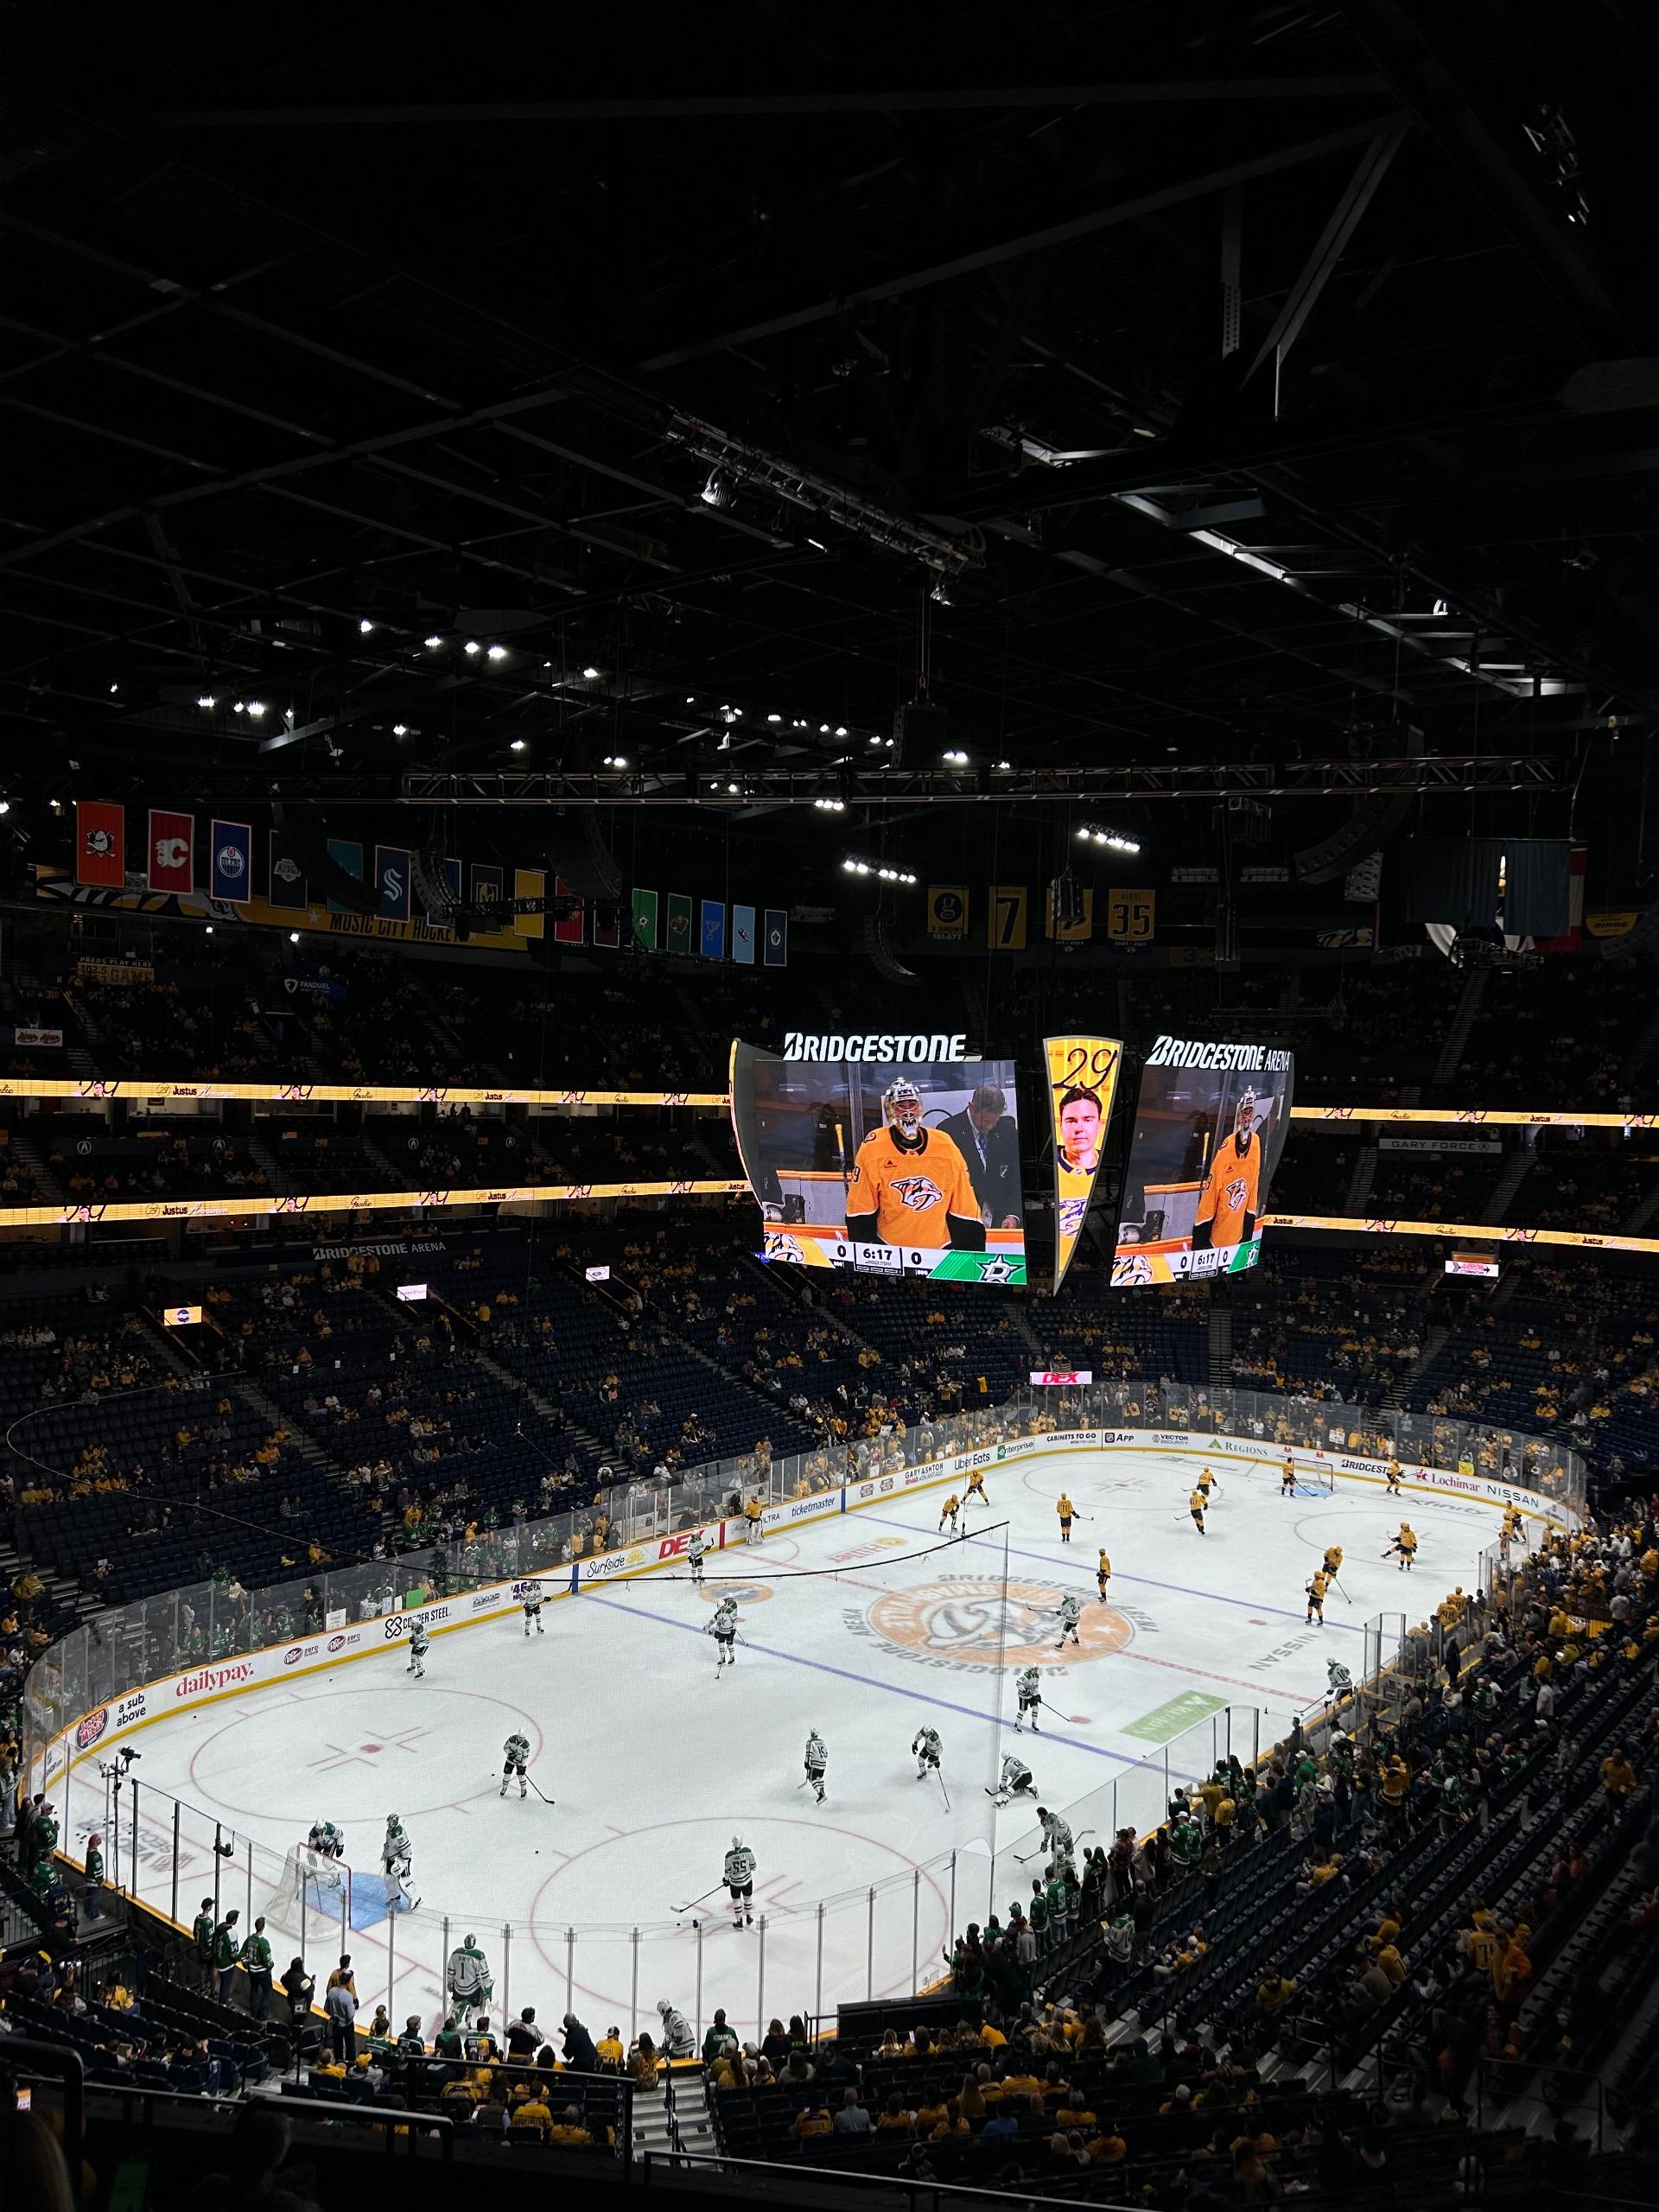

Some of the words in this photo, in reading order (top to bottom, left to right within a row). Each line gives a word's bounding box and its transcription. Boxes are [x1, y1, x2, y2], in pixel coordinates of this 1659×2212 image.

[330, 912, 373, 934] MUSIC
[378, 918, 408, 938] CITY
[995, 897, 1020, 944] 7
[1112, 903, 1152, 935] 35
[79, 957, 106, 965] PREDS
[300, 981, 330, 990] FANDUEL
[783, 1032, 966, 1062] BRIDGESTONE
[1145, 1035, 1265, 1071] BRIDGESTONE
[1264, 1050, 1290, 1071] ARENA
[1052, 1047, 1117, 1090] 29
[173, 1085, 197, 1096] Justus
[485, 1092, 503, 1101] Justus
[1391, 1141, 1426, 1149] GARY
[1432, 1141, 1475, 1151] FORCE
[488, 1192, 506, 1200] Justus
[162, 1205, 188, 1216] Justus
[312, 1243, 408, 1262] BRIDGESTONE
[411, 1241, 447, 1254] ARENA
[836, 1244, 847, 1258] 0
[862, 1249, 893, 1261] 6:17
[911, 1252, 922, 1265] 0
[1223, 1250, 1229, 1263] 0
[1181, 1256, 1188, 1268] 0
[1198, 1253, 1215, 1266] 6:17
[1046, 1433, 1075, 1442] CABINETS
[1000, 1441, 1033, 1457] enterprise
[1225, 1441, 1268, 1456] REGIONS
[954, 1457, 972, 1471] Uber
[973, 1452, 990, 1465] Eats
[905, 1469, 920, 1479] GARY
[920, 1463, 944, 1476] ASHTON
[1432, 1472, 1481, 1492] Lochinvar
[1487, 1484, 1539, 1508] NISSAN
[791, 1497, 836, 1517] ticketmaster
[587, 1555, 625, 1578] Surfside
[431, 1606, 450, 1622] STEEL
[1249, 1632, 1319, 1671] NISSAN
[119, 1703, 124, 1713] a
[127, 1693, 145, 1710] sub
[117, 1706, 146, 1727] above
[733, 1859, 748, 1875] 55
[461, 1962, 466, 1980] 1
